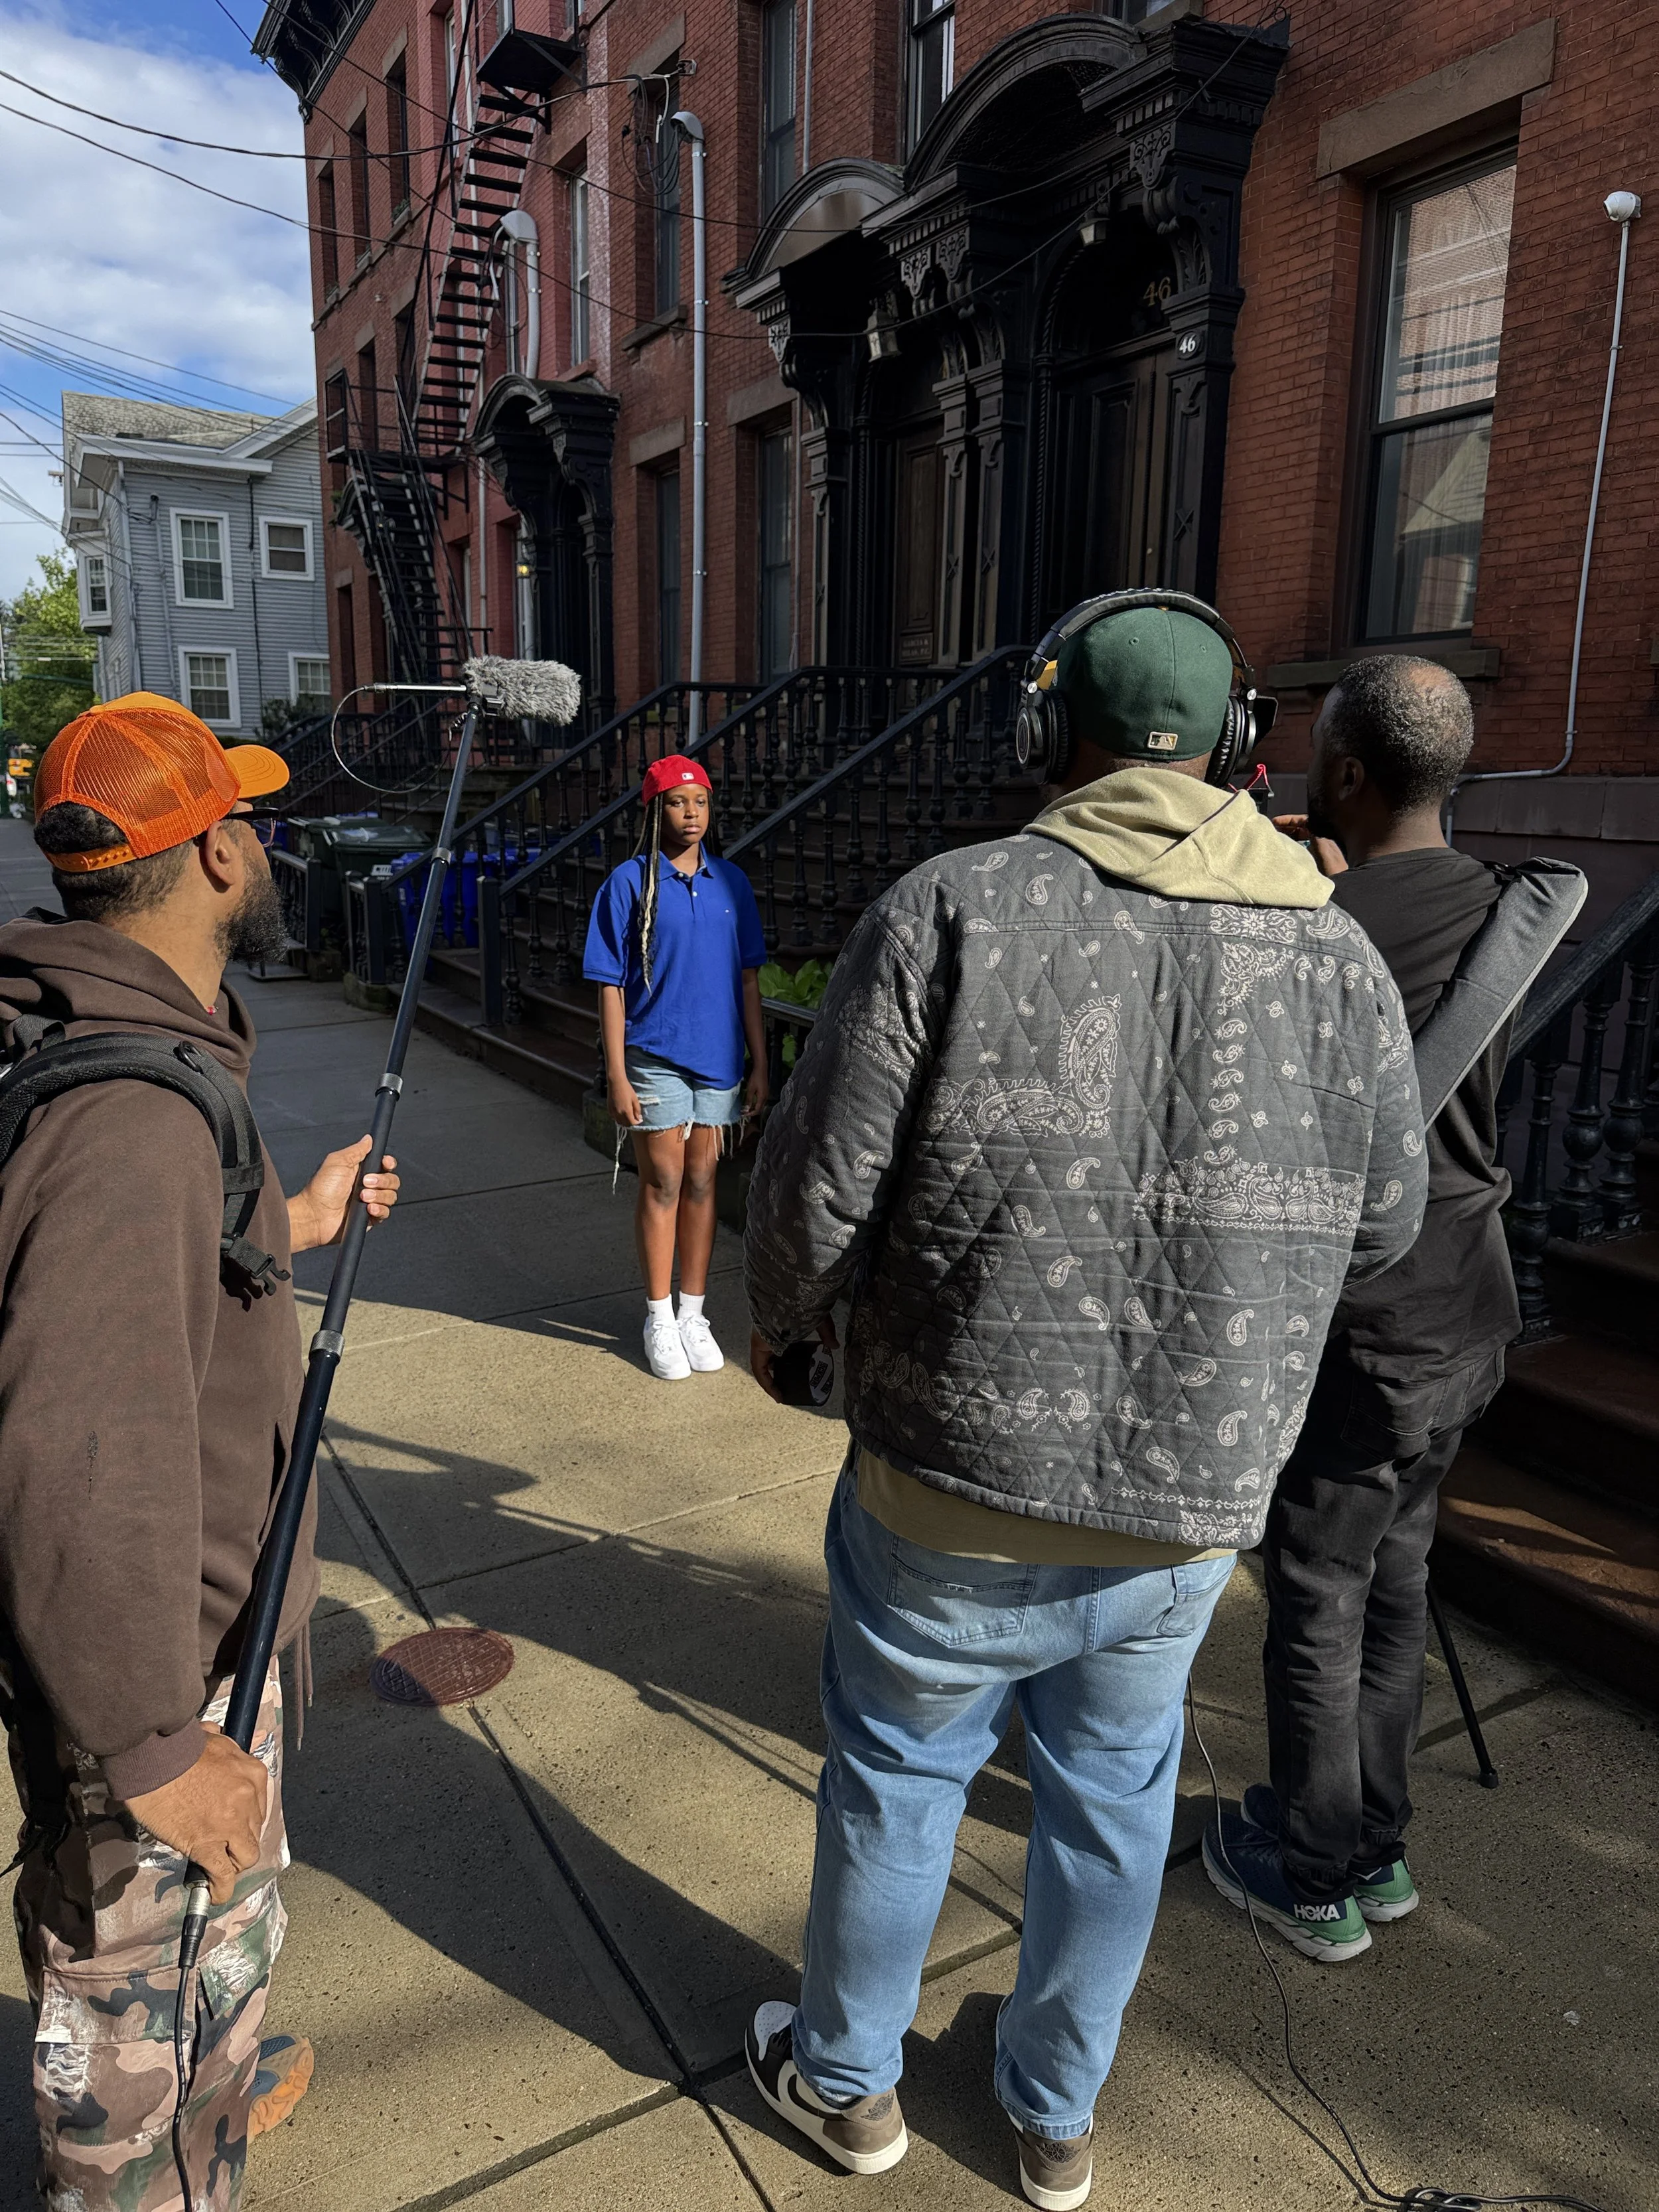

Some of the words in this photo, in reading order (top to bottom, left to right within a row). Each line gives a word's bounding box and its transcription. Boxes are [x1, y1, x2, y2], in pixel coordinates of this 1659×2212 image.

[1143, 276, 1171, 307] 46
[1179, 334, 1196, 353] 46
[1294, 1903, 1340, 1921] HOKA
